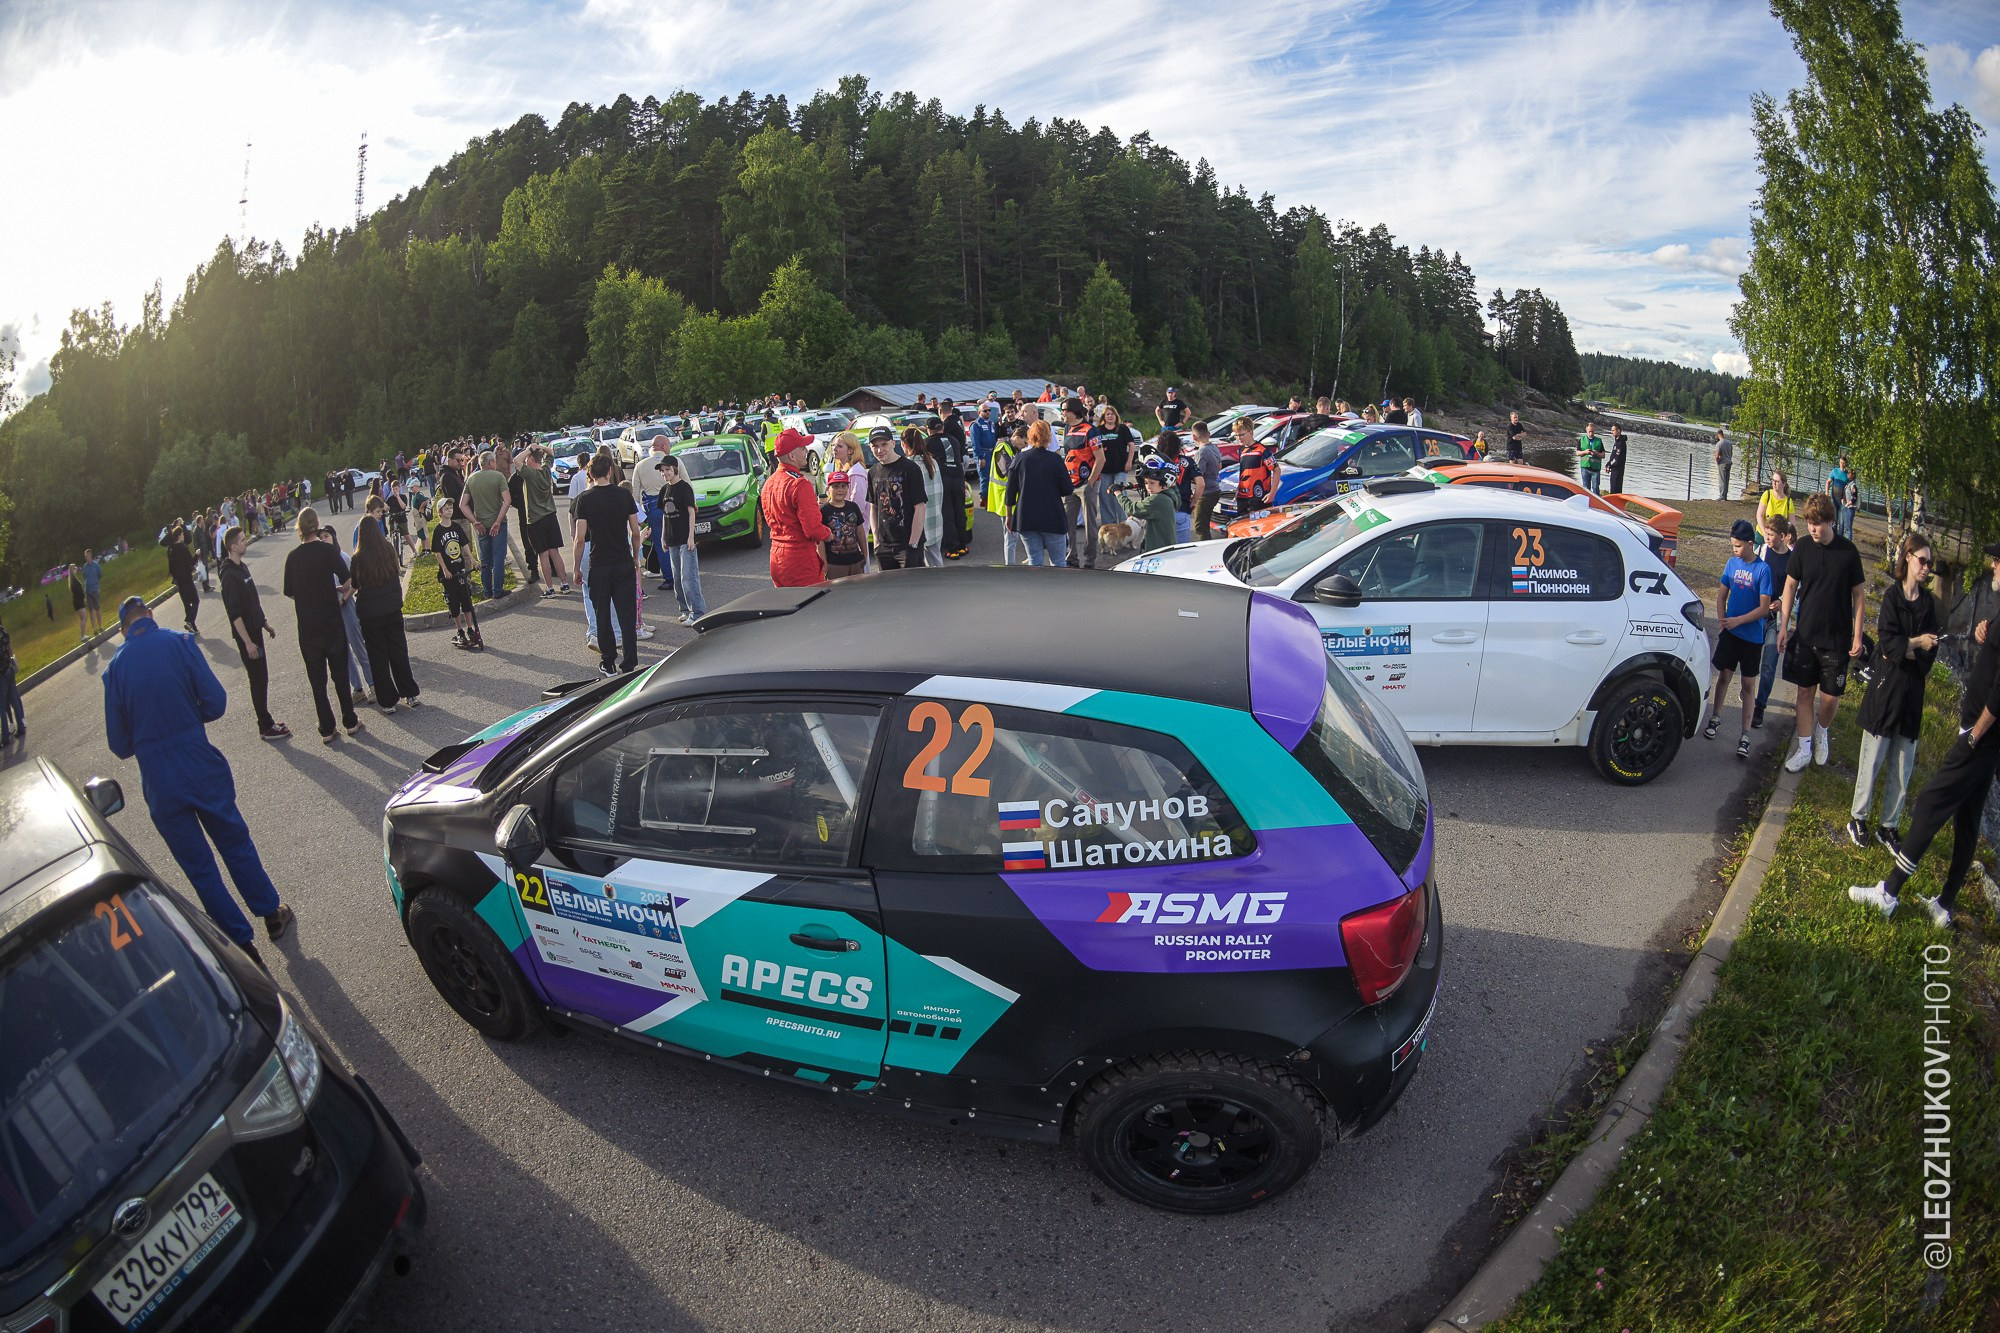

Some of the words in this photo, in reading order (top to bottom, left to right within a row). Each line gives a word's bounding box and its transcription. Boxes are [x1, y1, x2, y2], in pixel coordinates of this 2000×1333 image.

[1425, 439, 1440, 456] 26
[1337, 483, 1349, 493] 26
[1512, 527, 1545, 567] 23
[1528, 566, 1578, 579] Акимов
[1733, 569, 1753, 582] PUMA
[1528, 580, 1590, 594] Пюннонен
[1636, 624, 1678, 635] RAVENOL
[1369, 635, 1410, 648] НОЧИ
[902, 701, 995, 798] 22
[1044, 795, 1210, 831] Сапунов
[1049, 834, 1233, 869] Шатохина
[515, 872, 549, 907] 22
[639, 891, 670, 906] 2026
[551, 888, 613, 917] БЕЛЫЕ
[614, 902, 675, 929] НОЧИ
[1115, 891, 1289, 924] ASMG
[95, 893, 144, 951] 21
[581, 935, 631, 952] ТАТНЕФТЬ
[1154, 934, 1221, 946] RUSSIAN
[1225, 934, 1273, 946] RALLY
[1185, 949, 1271, 961] PROMOTER
[721, 953, 873, 1010] APECS
[896, 1009, 963, 1024] автомобилей
[923, 1004, 961, 1015] импорт
[765, 1016, 842, 1039] APECSAUTO.RU
[174, 1181, 221, 1230] 799
[200, 1212, 220, 1233] RUS
